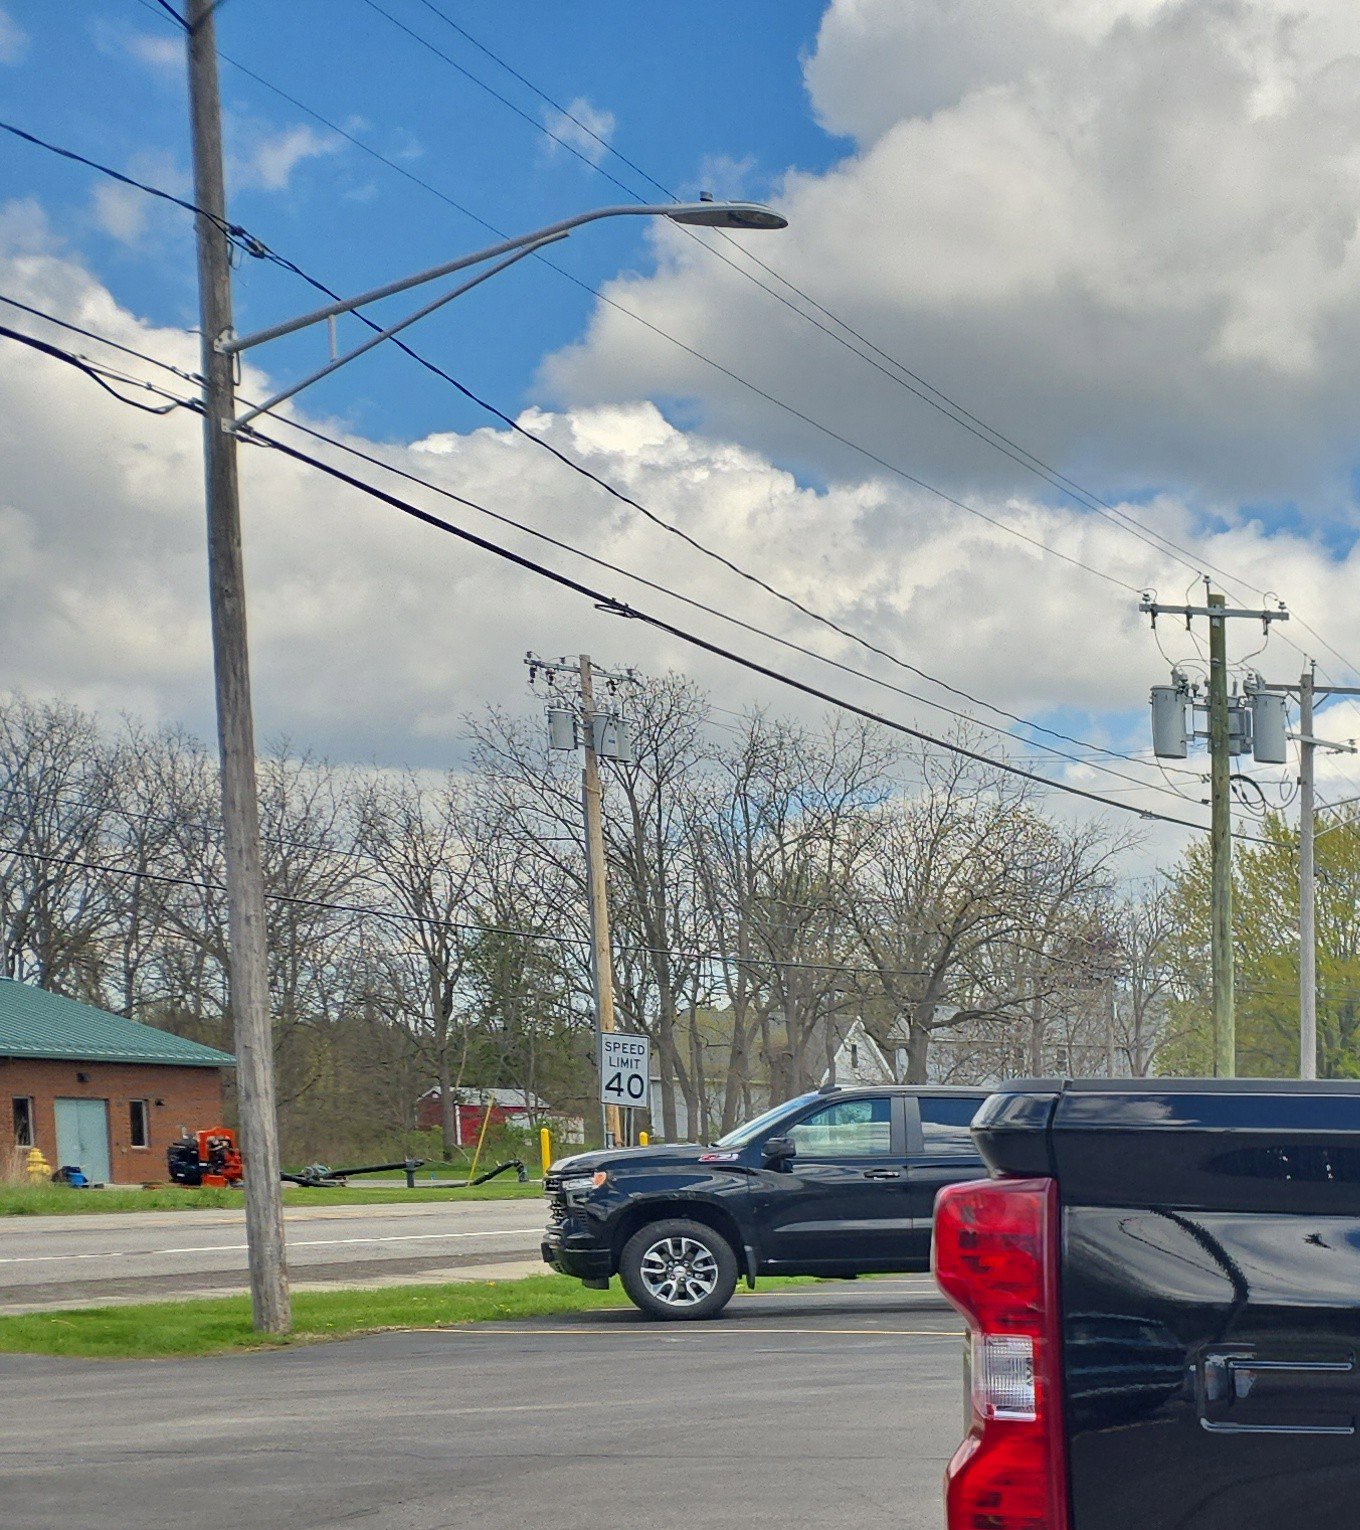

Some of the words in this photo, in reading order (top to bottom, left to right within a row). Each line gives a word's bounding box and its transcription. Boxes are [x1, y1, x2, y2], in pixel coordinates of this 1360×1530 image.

[605, 1042, 644, 1055] SPEED
[609, 1057, 640, 1069] LIMIT
[605, 1072, 645, 1099] 40
